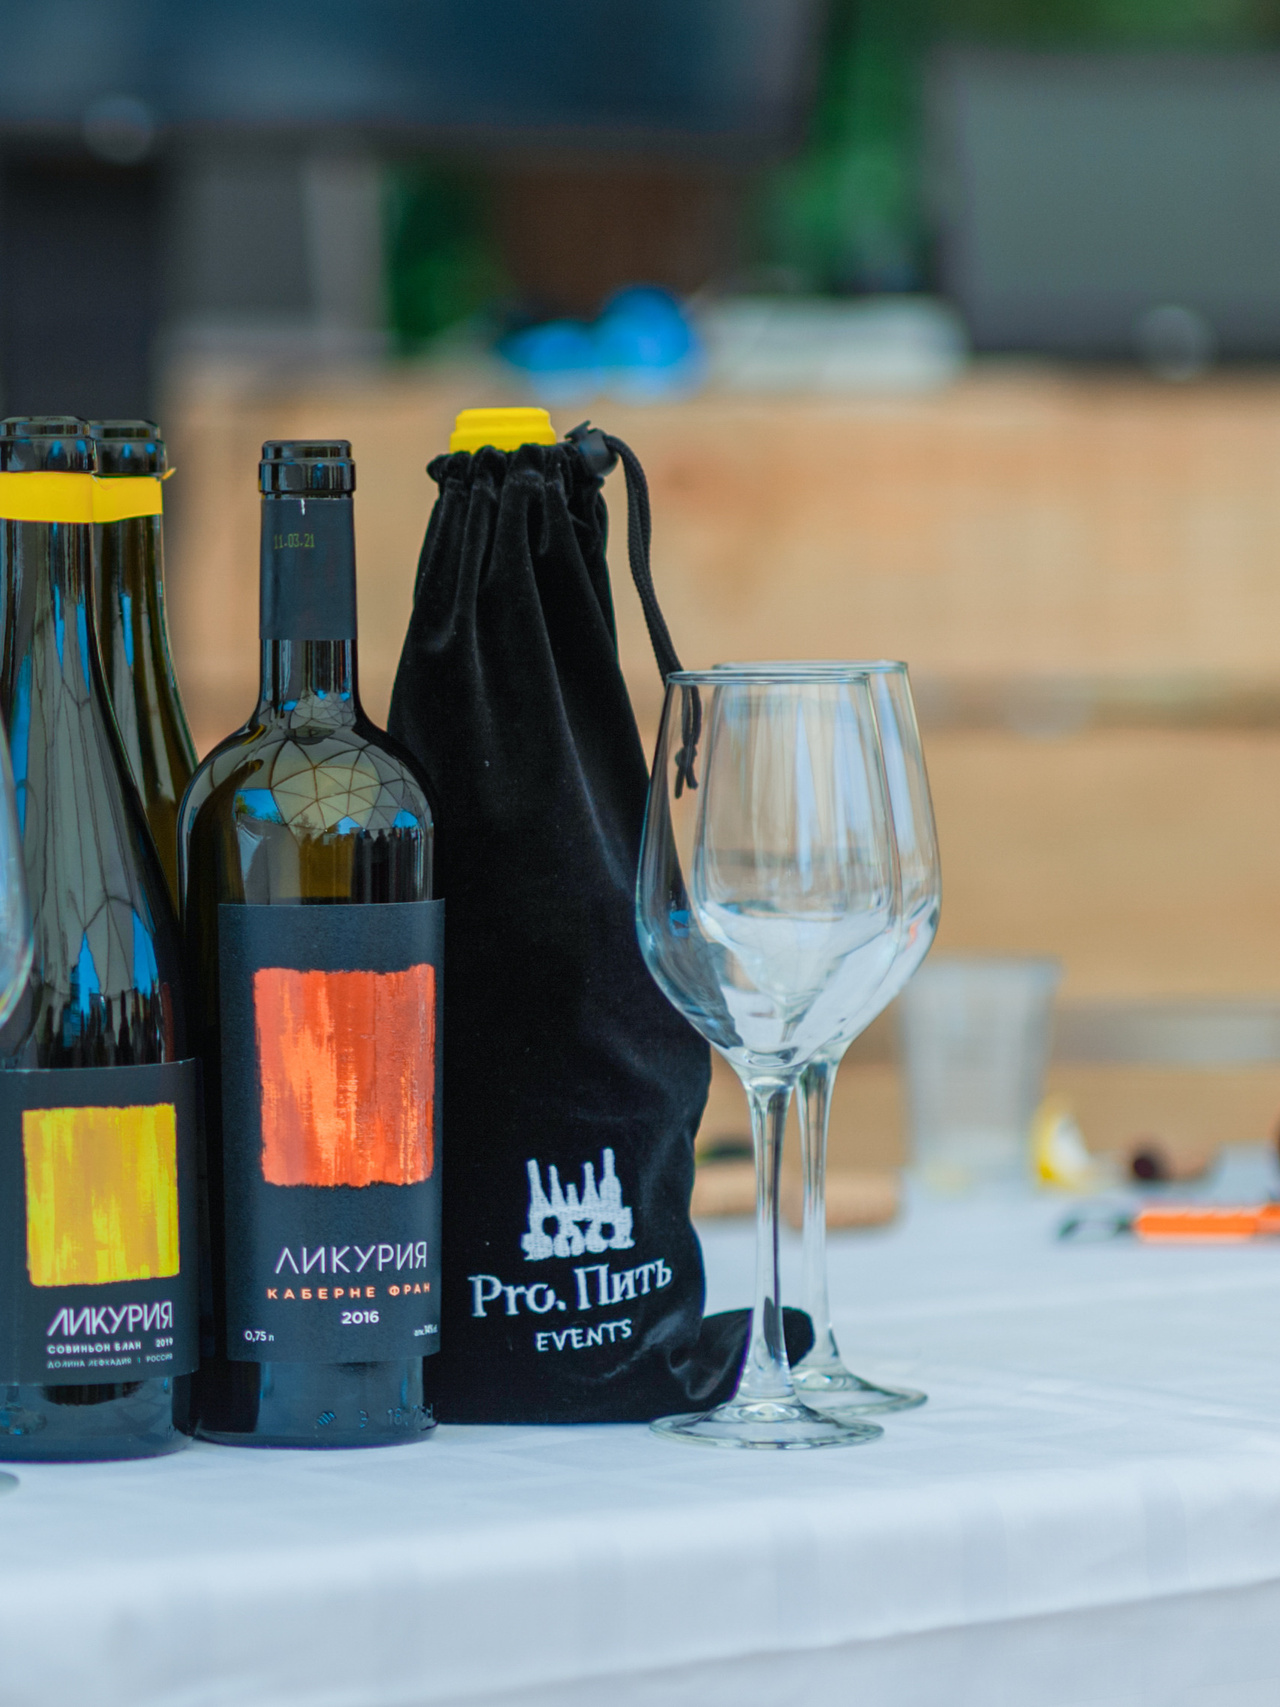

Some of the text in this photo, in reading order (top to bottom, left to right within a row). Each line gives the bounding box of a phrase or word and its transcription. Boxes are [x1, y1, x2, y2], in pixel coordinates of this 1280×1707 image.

[274, 533, 324, 549] 11.03.21
[274, 1241, 428, 1274] ЛИКУРИЯ
[267, 1283, 430, 1300] КАБЕРНЕ ФРАН
[47, 1301, 173, 1337] ЛИКУРИЯ
[341, 1311, 380, 1324] 2016
[244, 1330, 267, 1342] 0,75
[536, 1318, 632, 1352] EVENTS
[47, 1337, 173, 1355] СОВИНЬОН БЛАН 2019
[47, 1360, 86, 1369] ДОЛИНА
[146, 1353, 173, 1363] РОССИЯ
